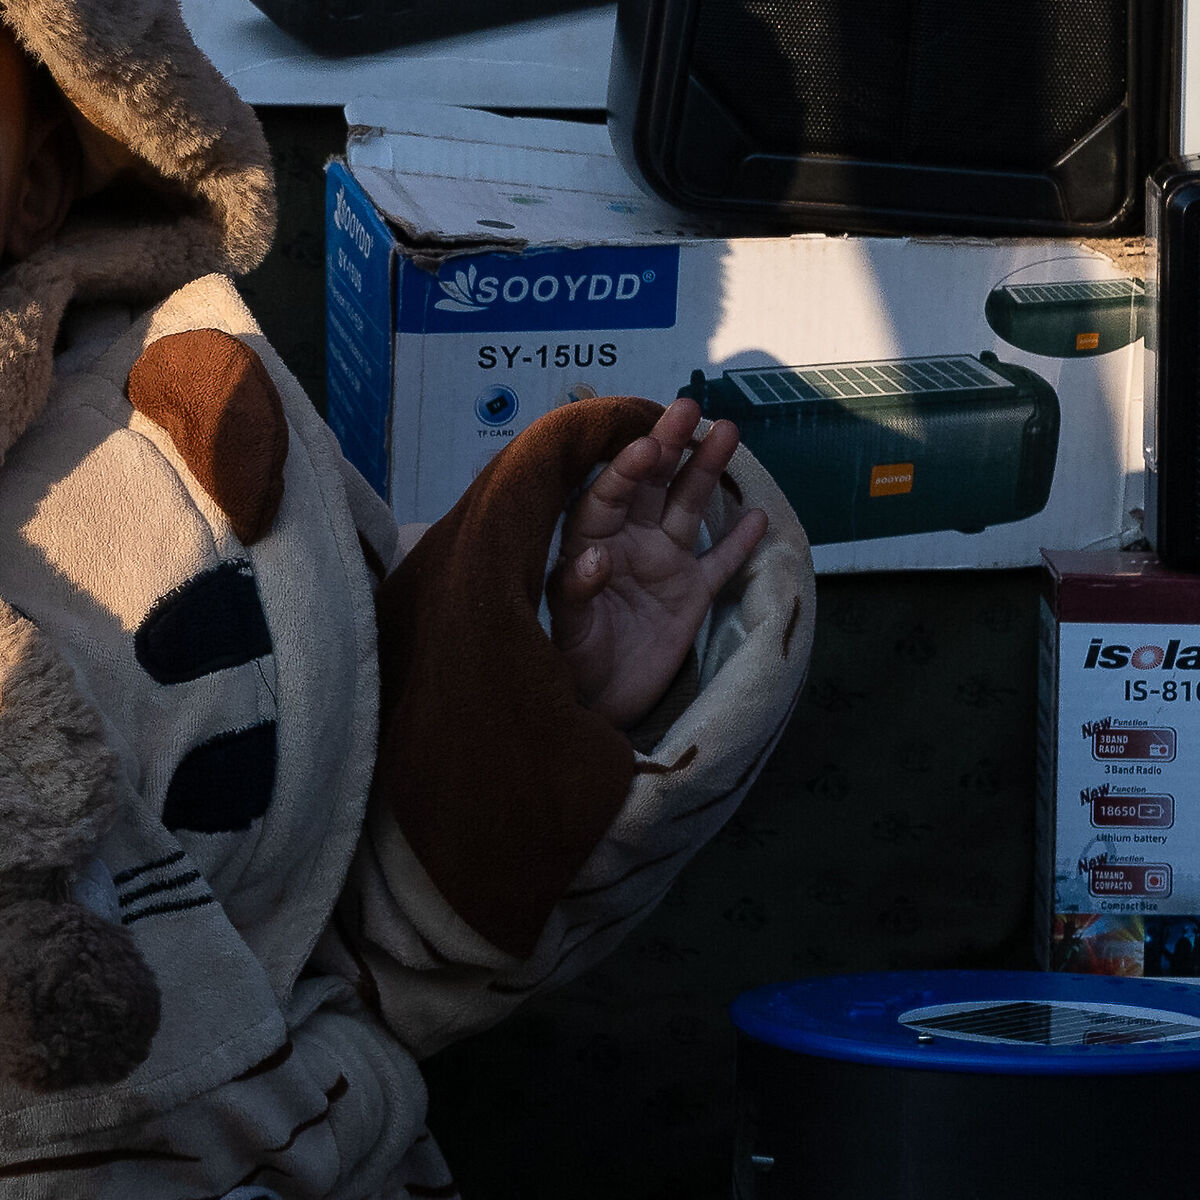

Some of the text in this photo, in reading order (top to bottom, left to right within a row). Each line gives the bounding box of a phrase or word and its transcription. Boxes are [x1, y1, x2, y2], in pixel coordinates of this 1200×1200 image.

[477, 343, 618, 370] SY-15US
[489, 429, 515, 437] CARD
[1113, 718, 1148, 726] Function
[1099, 745, 1125, 754] RADIO
[1136, 766, 1162, 775] Radio
[1111, 785, 1147, 793] Function
[1100, 806, 1136, 817] 18650
[1096, 833, 1168, 845] Lithium battery
[1109, 854, 1145, 862] Function
[1094, 881, 1134, 891] COMPACTO
[1101, 901, 1139, 913] Compact
